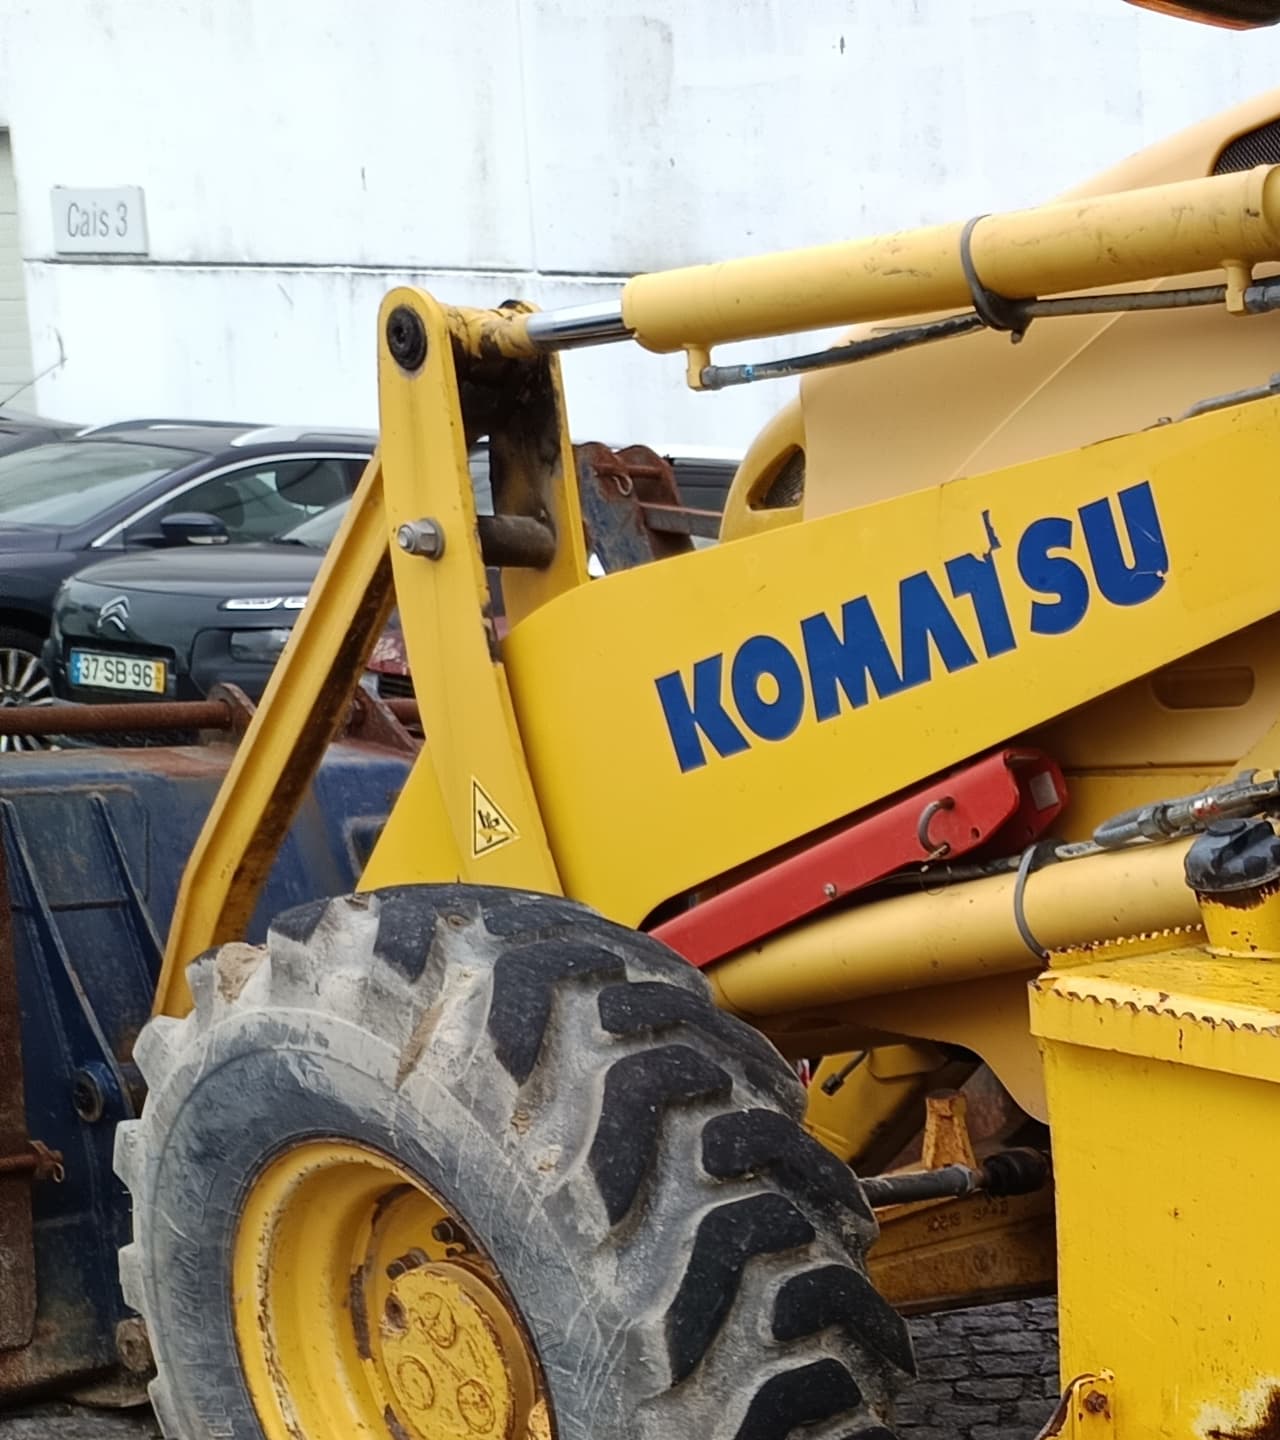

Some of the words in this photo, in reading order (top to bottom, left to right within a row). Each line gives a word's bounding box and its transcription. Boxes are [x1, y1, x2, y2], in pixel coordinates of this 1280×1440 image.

[67, 201, 109, 238] Cais
[115, 201, 128, 238] 3
[655, 480, 1170, 774] KOMATSU
